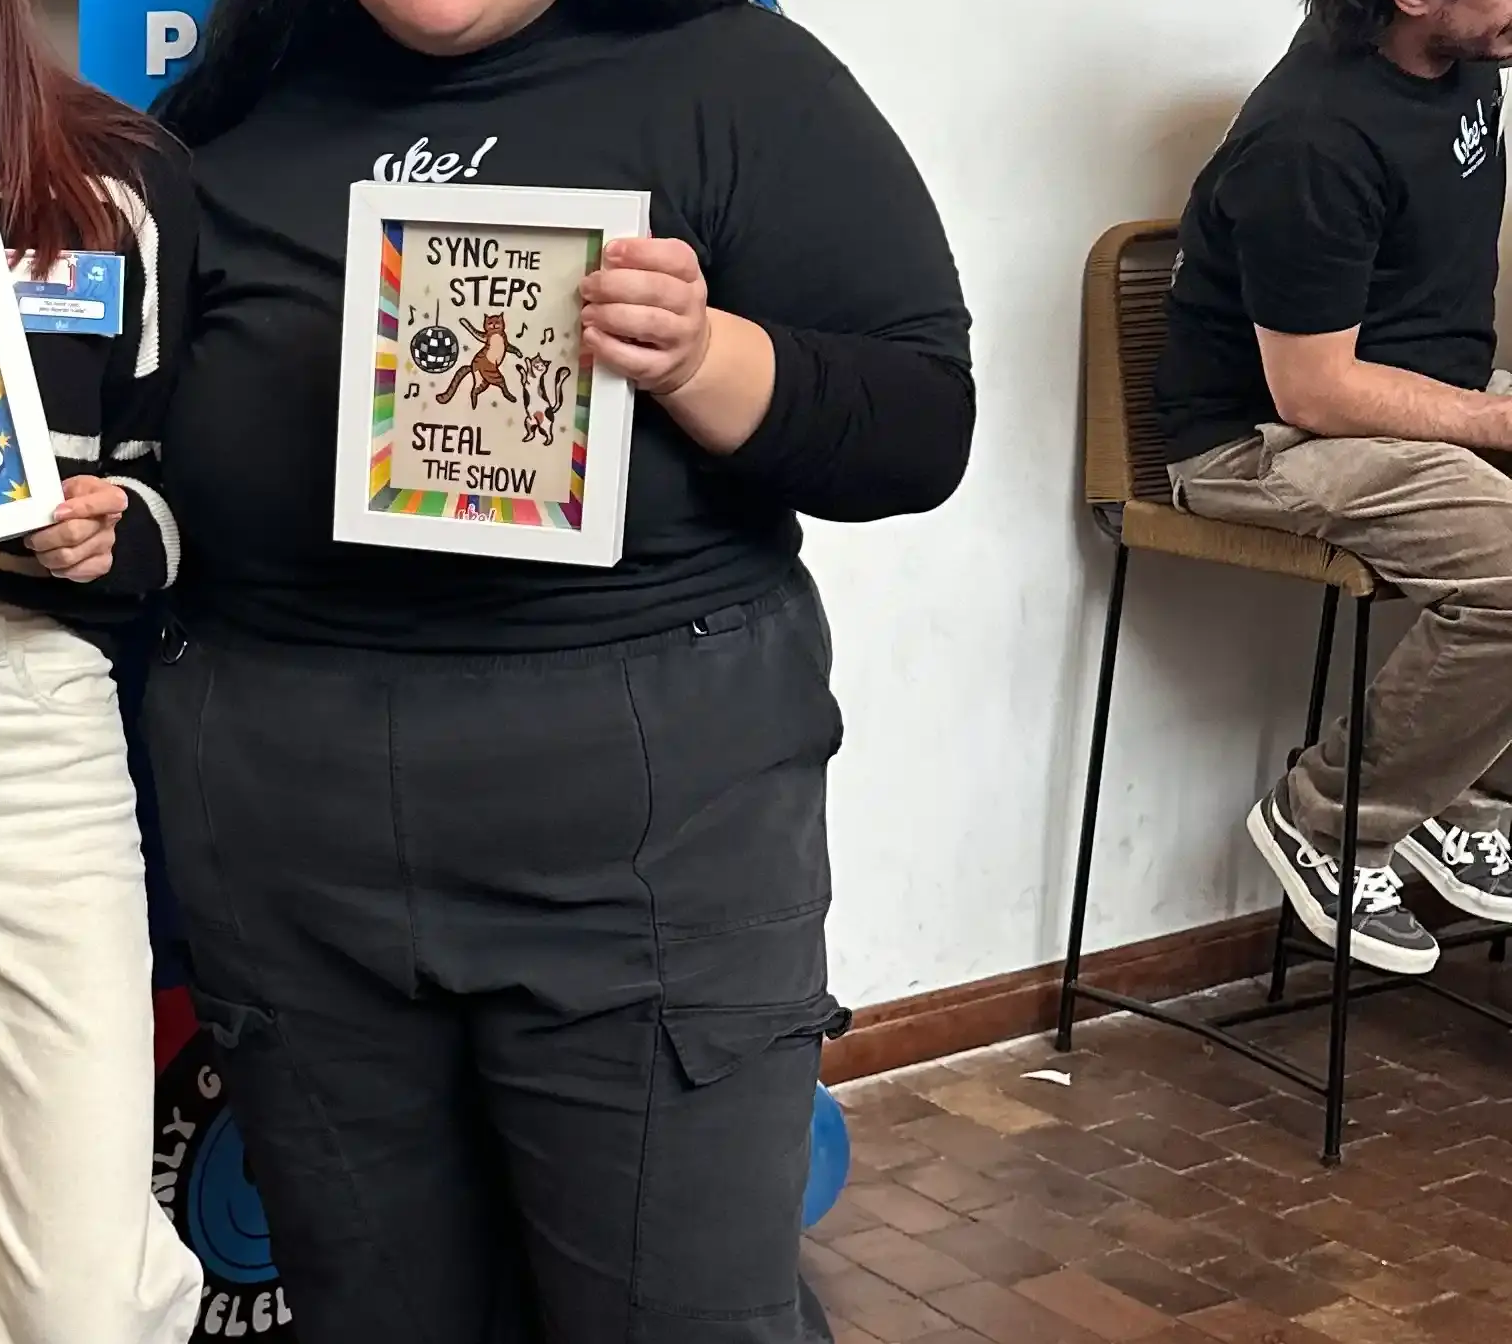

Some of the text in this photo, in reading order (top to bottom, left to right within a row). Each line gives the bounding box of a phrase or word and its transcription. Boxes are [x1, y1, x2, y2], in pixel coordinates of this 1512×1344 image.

[426, 236, 542, 271] SYNC THE
[449, 275, 542, 311] STEPS
[411, 422, 492, 456] STEAL
[422, 459, 537, 494] THE SHOW
